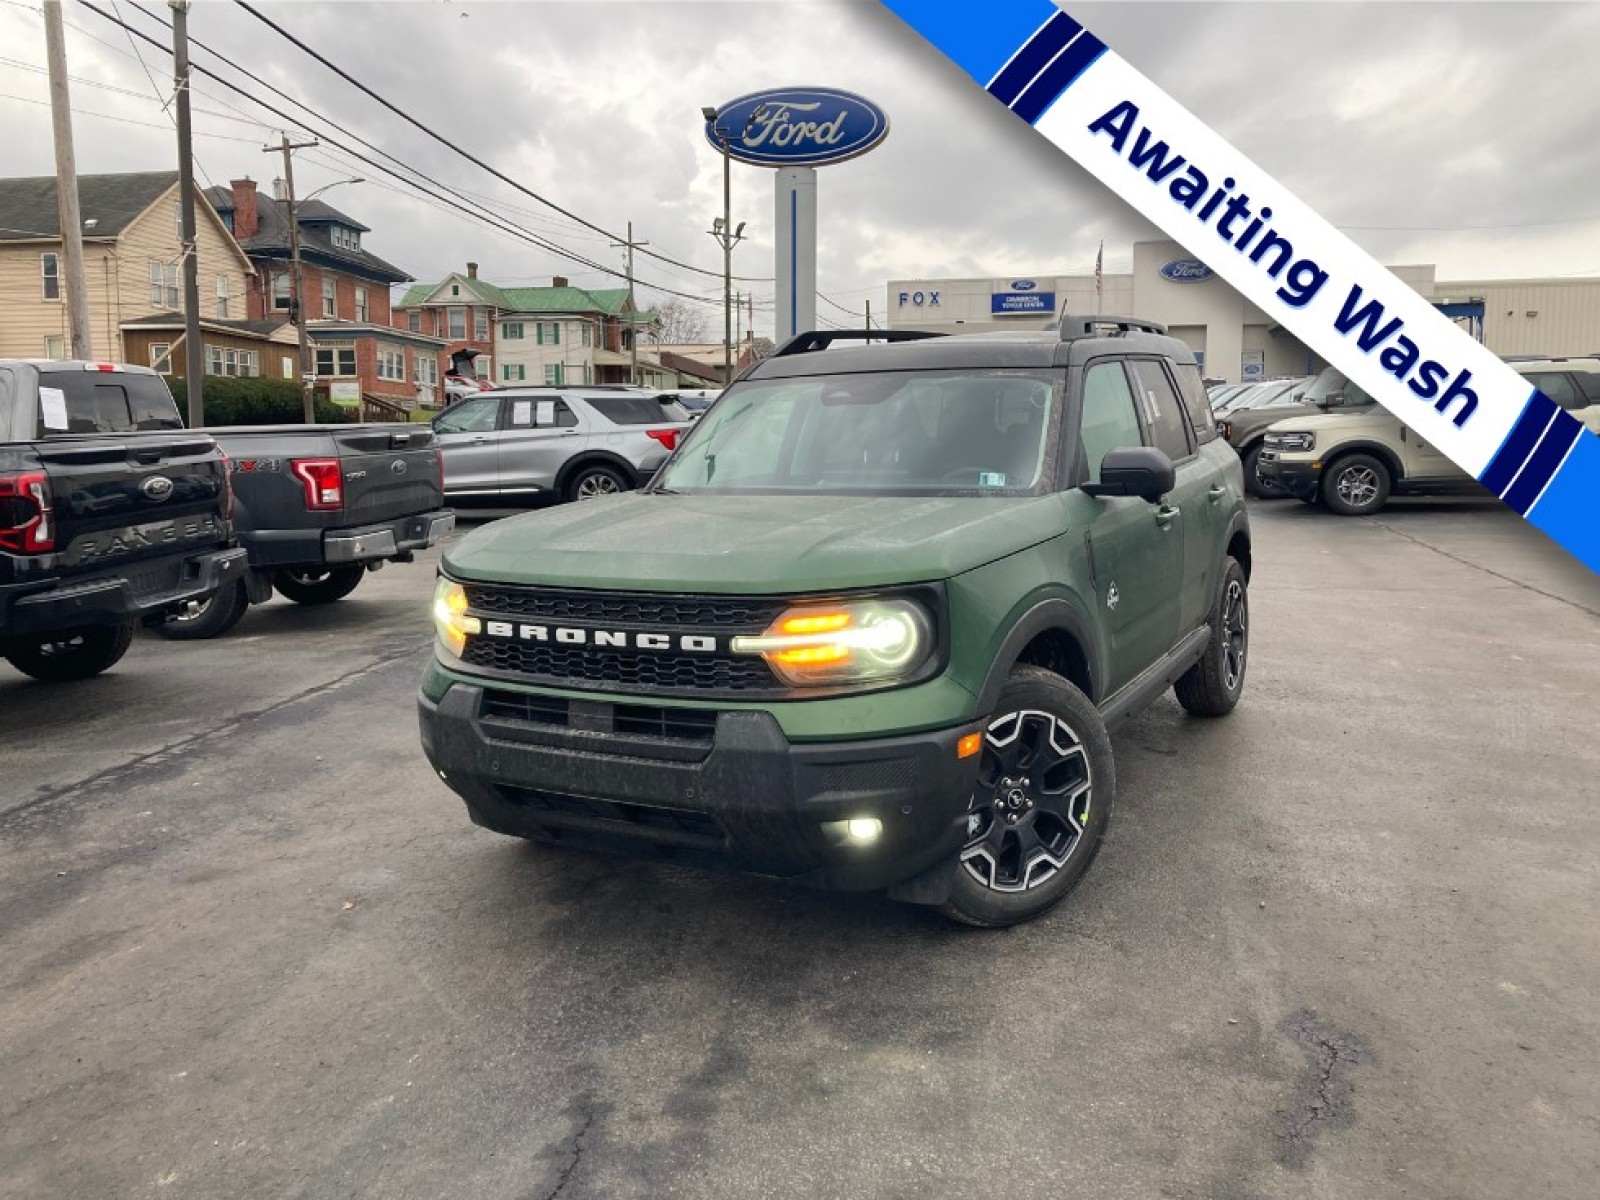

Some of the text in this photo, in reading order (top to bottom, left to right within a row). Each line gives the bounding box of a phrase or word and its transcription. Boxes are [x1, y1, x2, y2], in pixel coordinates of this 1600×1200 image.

[742, 101, 848, 147] Ford
[1172, 262, 1206, 277] Ford
[899, 291, 940, 307] FOX
[487, 620, 716, 651] BRONCO
